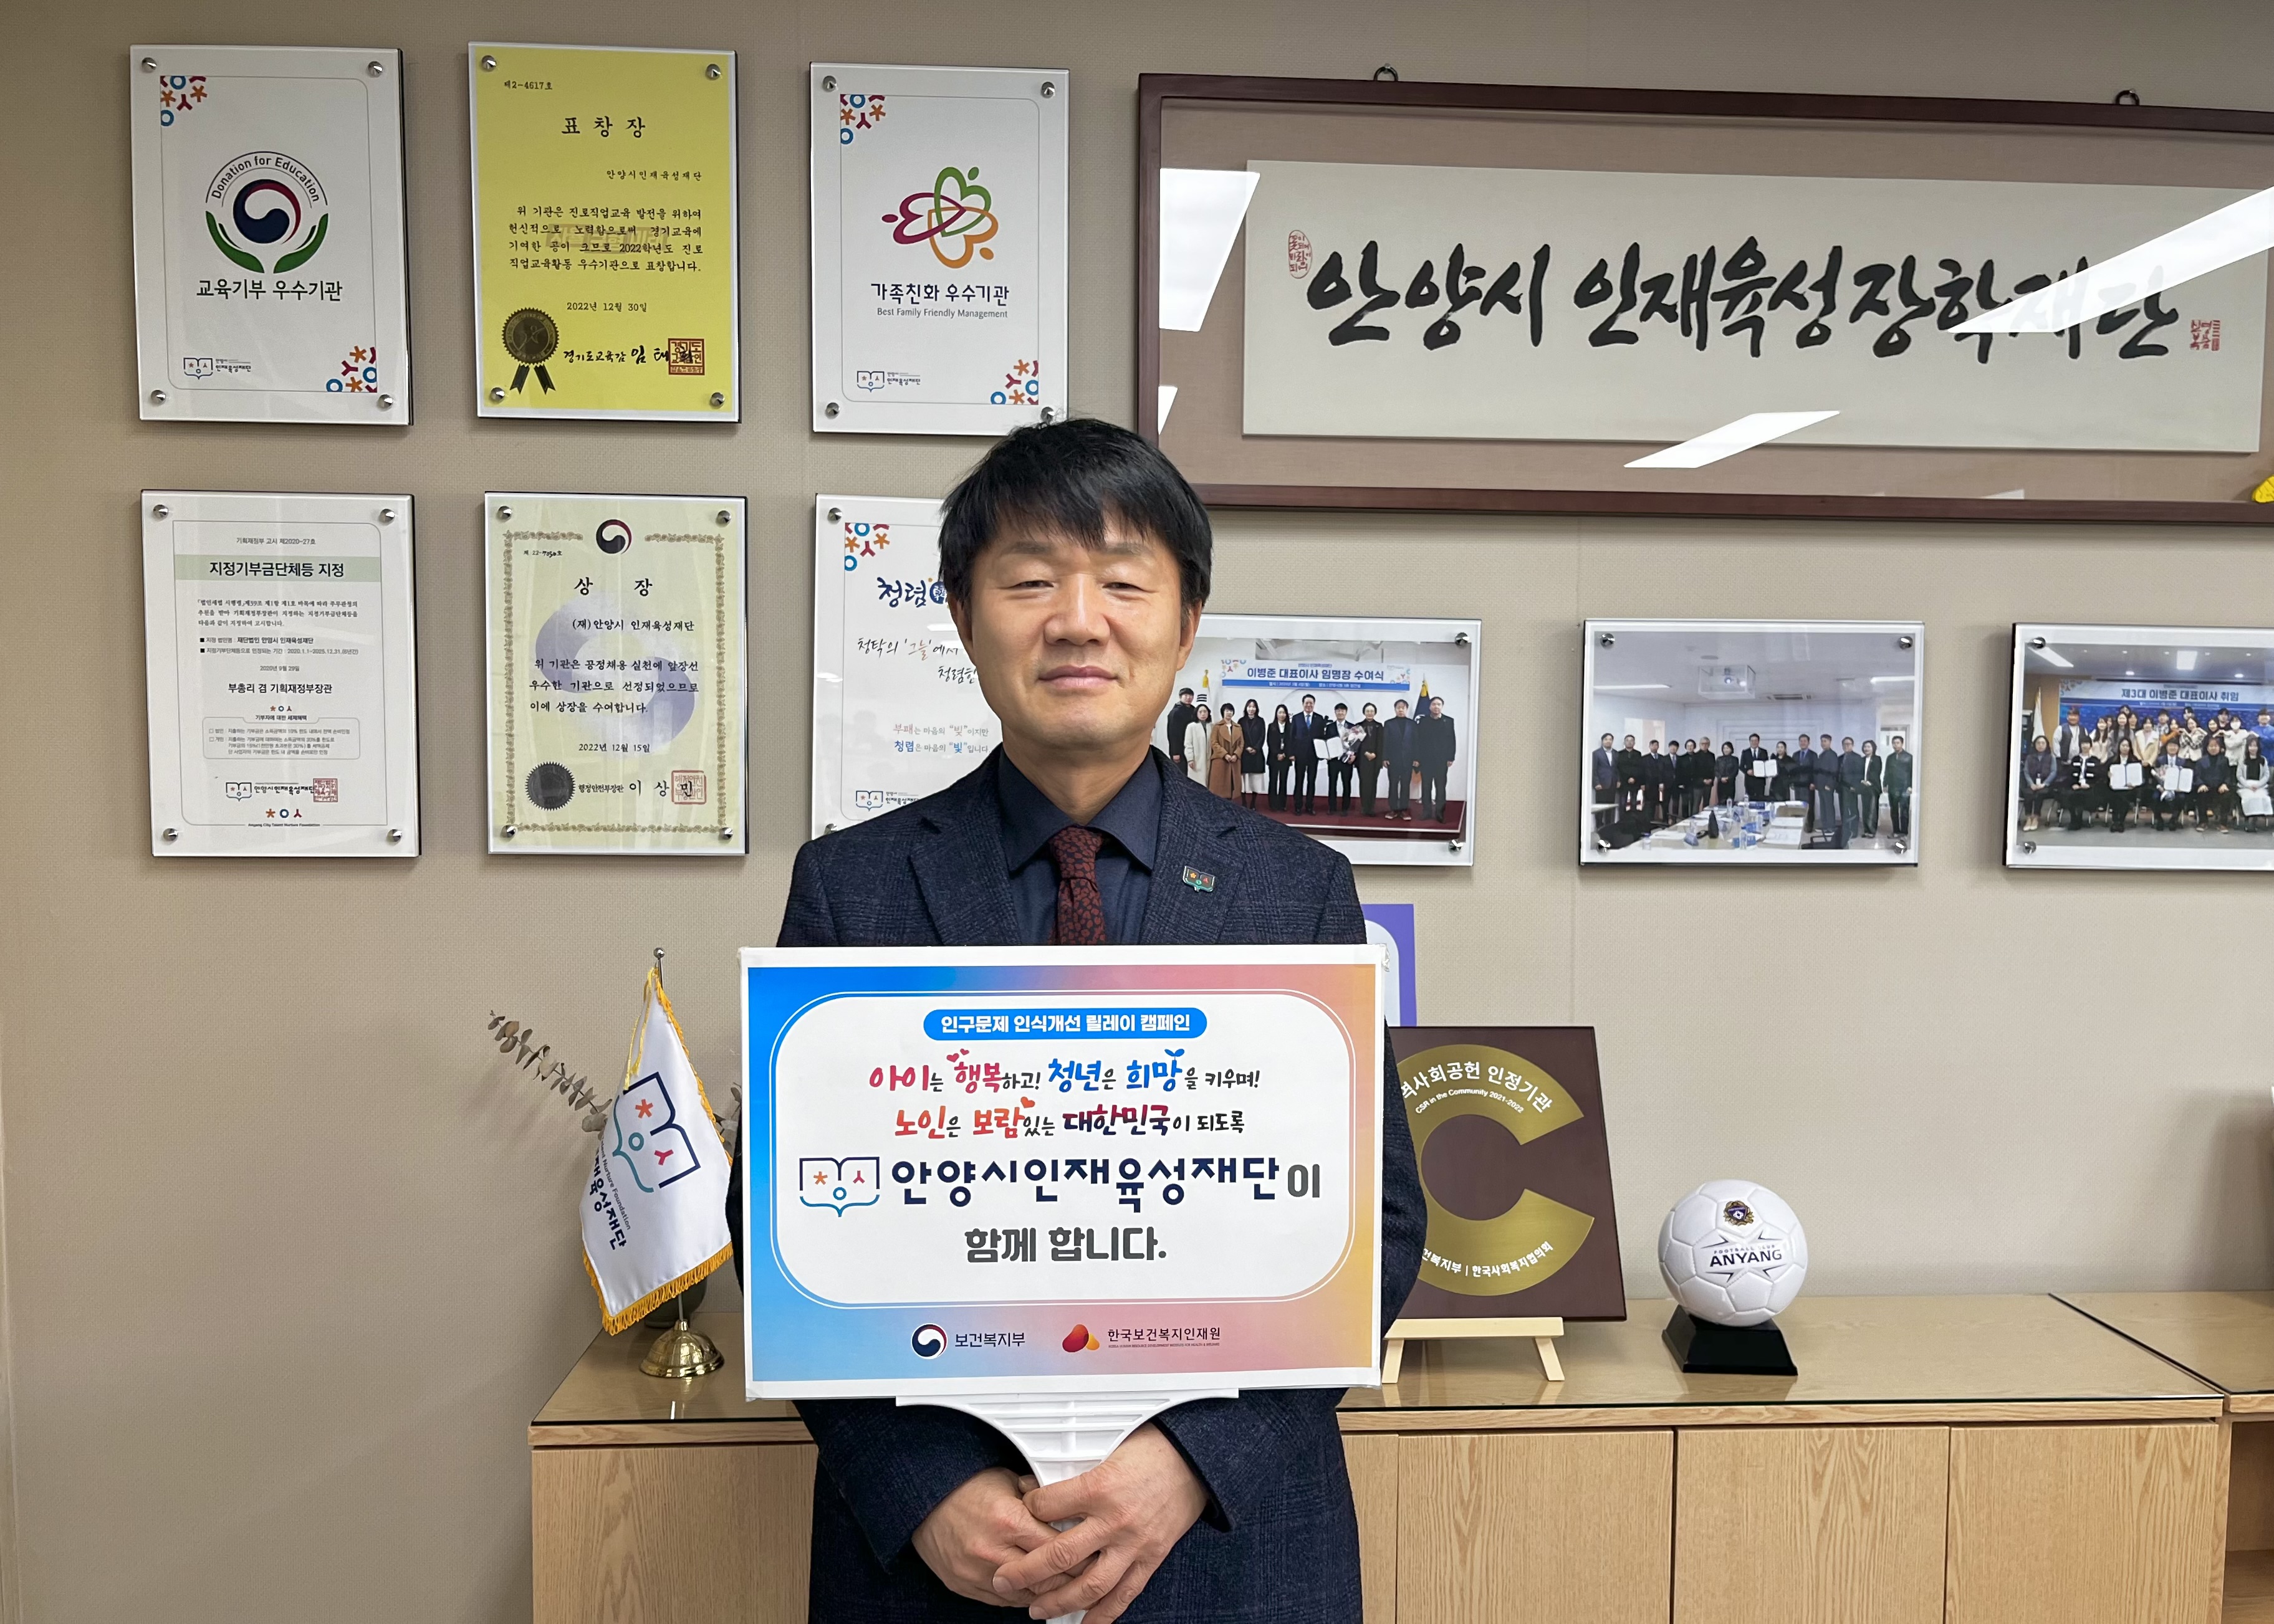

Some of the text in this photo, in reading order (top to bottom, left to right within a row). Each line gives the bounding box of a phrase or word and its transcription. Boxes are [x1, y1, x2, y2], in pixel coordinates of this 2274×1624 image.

[211, 156, 320, 203] Donation for Education
[517, 206, 701, 220] 위 기관은 진로직업교육 발전을 위하여
[509, 224, 561, 235] 헌신적으로
[575, 225, 636, 236] 노력함으로써
[651, 226, 701, 237] 경기교육에
[509, 241, 541, 251] 기여한
[550, 241, 570, 252] 공이
[620, 243, 673, 254] 2022학년도
[683, 244, 703, 254] 진로
[509, 259, 701, 272] 직업교육활동 우수기관으로 표창합니다.
[196, 279, 343, 302] 교육기부 우수기관
[871, 283, 1009, 306] 가족친화 우수기관
[1307, 241, 1550, 350] 안양시
[567, 302, 647, 312] 2022년 12월 30일
[897, 308, 921, 318] Family
[924, 308, 955, 319] Friendly
[958, 309, 1007, 319] Management
[209, 562, 343, 577] 지정기부금단체등 지정
[631, 619, 694, 632] 인재육성재단
[858, 638, 898, 657] 청탁의
[535, 659, 699, 672] 위 기관은 공정채용 실천에 앞장선
[1247, 667, 1383, 681] 이병준 대표이사 임명장 수여식
[228, 684, 332, 694] 부총리 겸 기획재정부장관
[529, 681, 699, 693] 우수한 기관으로 선정되었으므로
[2121, 689, 2146, 698] 제3대
[2180, 690, 2217, 700] 대표이사
[530, 702, 648, 714] 이에 상장을 수여합니다.
[893, 724, 921, 735] 부패는
[924, 727, 945, 735] 마음의
[578, 743, 650, 753] 2022년 12월 15일
[895, 740, 921, 752] 청렴은
[924, 743, 946, 752] 마음의
[941, 1014, 1190, 1034] 인구문제 인식개선 릴레이 캠페인
[870, 1058, 1260, 1093] 아이는 행복하고! 청년은 희망을 키우며!
[1488, 1066, 1553, 1113] 인정기관
[1415, 1100, 1430, 1114] CSR
[1436, 1092, 1447, 1101] the
[1448, 1088, 1489, 1097] Community
[1489, 1091, 1524, 1114] 2021-2022
[895, 1104, 1245, 1139] 노인은 보람있는 대한민국이 되도록
[612, 1188, 631, 1230] Foundation
[965, 1226, 1167, 1263] 함께 합니다.
[1472, 1241, 1553, 1278] 한국사회복지협의회
[1710, 1249, 1782, 1267] ANYANG
[954, 1332, 1025, 1348] 보건복지부
[1107, 1327, 1221, 1342] 한국보건복지인재원
